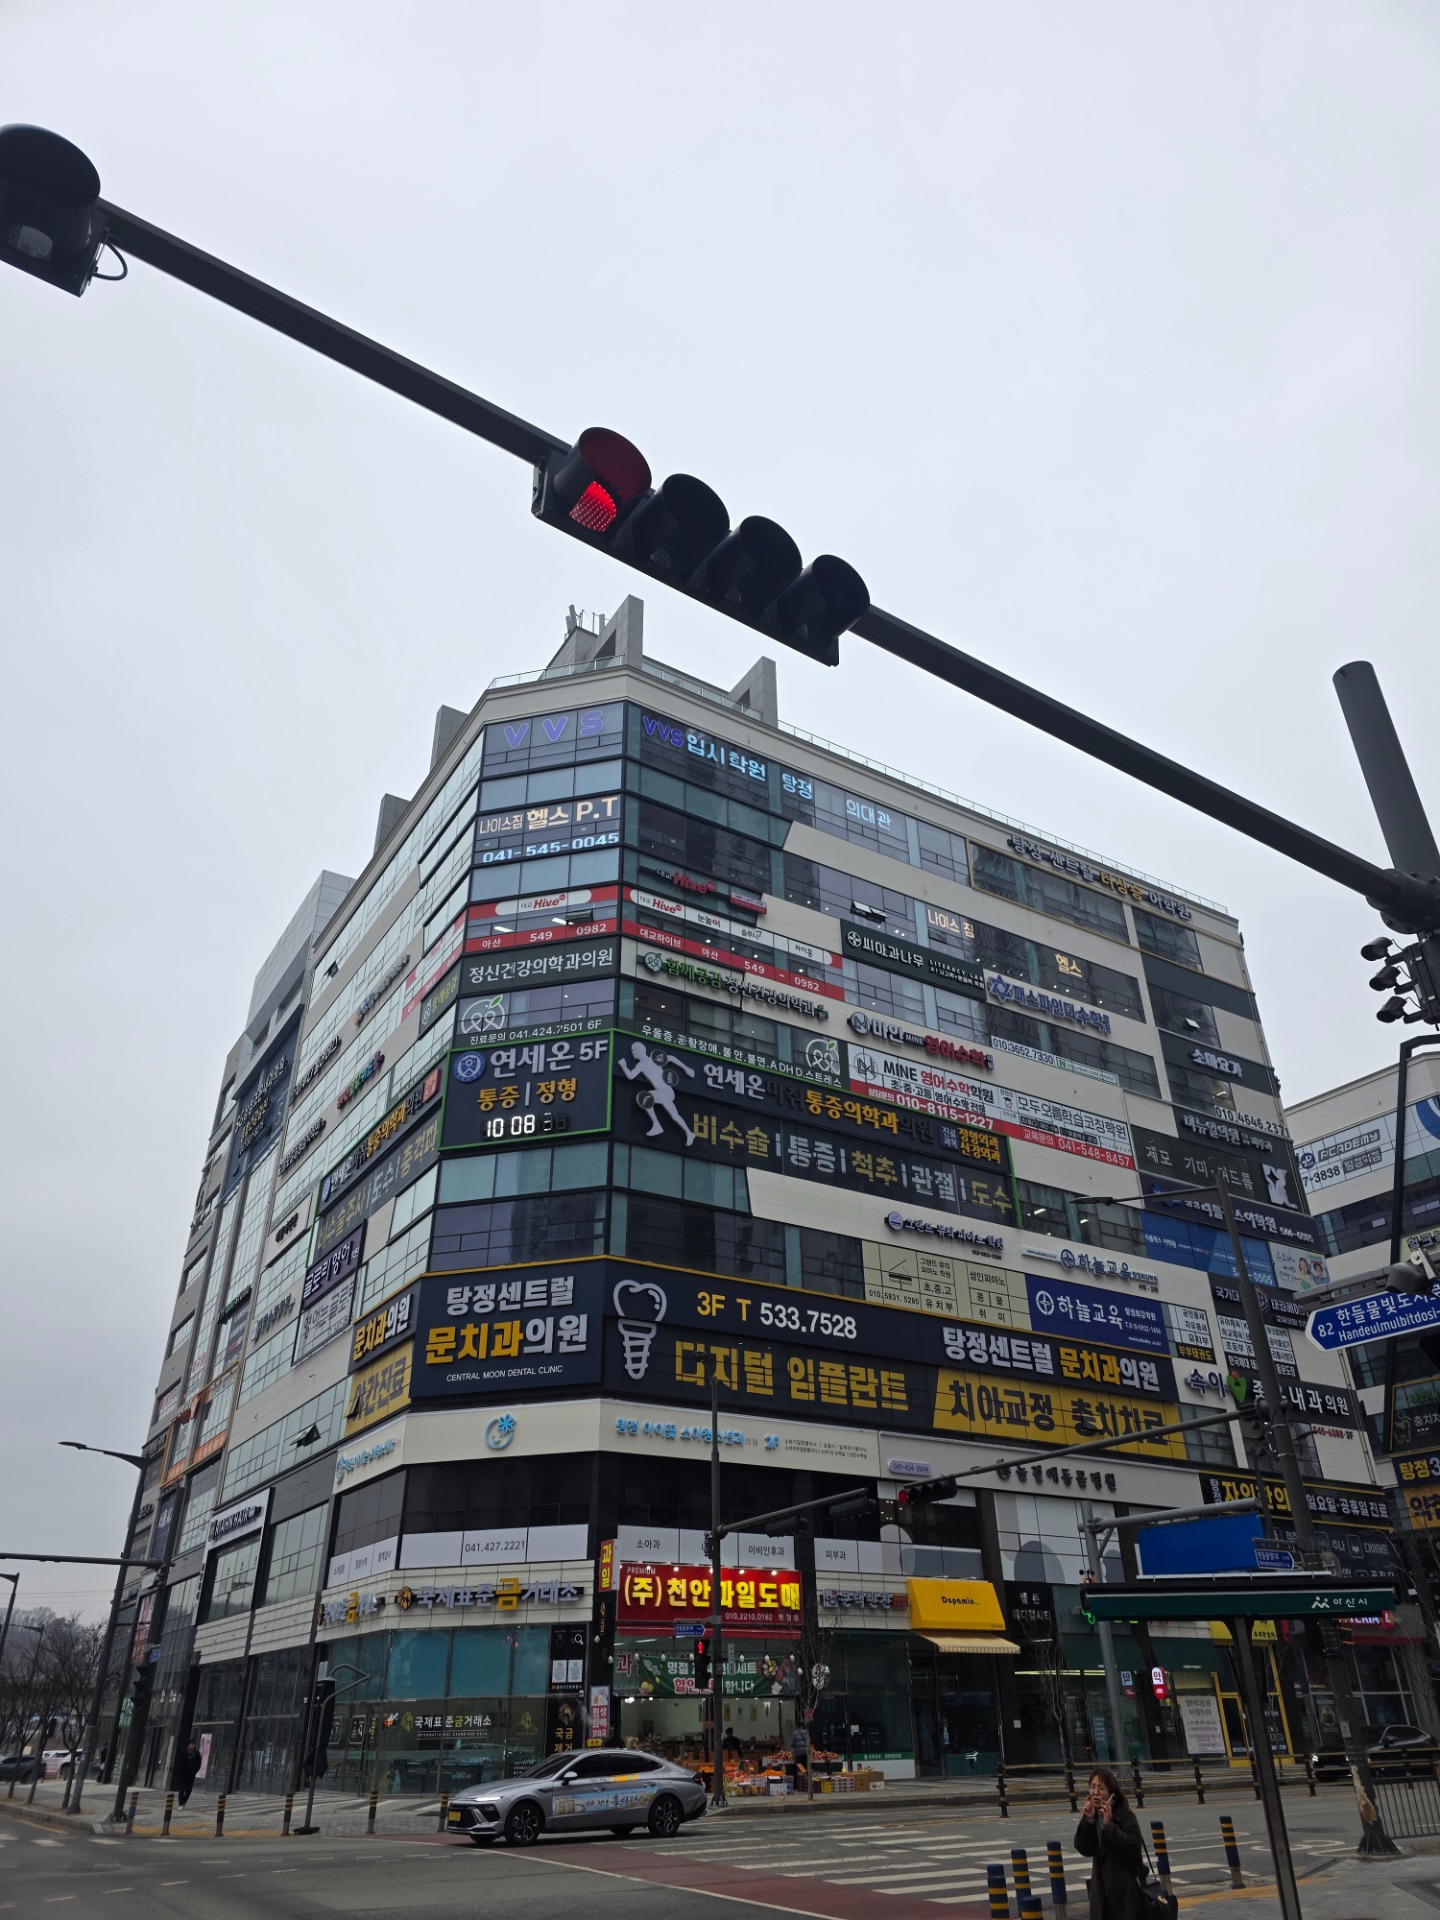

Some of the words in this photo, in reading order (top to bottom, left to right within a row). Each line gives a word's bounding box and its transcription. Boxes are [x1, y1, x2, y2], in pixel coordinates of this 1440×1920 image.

[504, 710, 604, 748] VVS
[782, 772, 813, 800] 탕정
[527, 805, 569, 830] 헬스
[482, 832, 619, 863] 041-545-0045
[534, 895, 560, 908] Hive
[652, 898, 676, 914] Hive
[697, 913, 721, 928] 눈높이
[482, 938, 501, 949] 아산
[530, 930, 552, 943] 549
[576, 923, 607, 936] 0982
[469, 948, 613, 984] 정신건강의학과의원
[640, 928, 682, 948] 대교하이브
[702, 947, 718, 961] 아산
[744, 961, 765, 974] 549
[794, 977, 819, 992] 0982
[1055, 952, 1082, 977] 헬스
[509, 1022, 583, 1041] 041.424.7501
[587, 1019, 602, 1030] 6F
[872, 1017, 904, 1043] 마인
[490, 1041, 575, 1079] 연세온
[579, 1040, 608, 1061] 5F
[883, 1060, 917, 1082] MINE
[477, 1085, 520, 1111] 통증
[536, 1078, 577, 1104] 정형
[703, 1063, 766, 1100] 연세온
[693, 1113, 770, 1158] 비수술
[787, 1135, 836, 1174] 통증
[851, 1150, 898, 1186] 척추
[911, 1165, 956, 1202] 관절
[971, 1180, 1013, 1214] 도수
[1059, 1138, 1130, 1166] 041-548-8457
[447, 1276, 575, 1316] 탕정센트럴
[353, 1293, 412, 1361] 문치과의원
[697, 1292, 726, 1316] 3F
[736, 1298, 752, 1321] T
[760, 1302, 857, 1339] 533.7528
[1057, 1296, 1122, 1330] 하늘교육
[425, 1314, 589, 1365] 문치과의원
[1318, 1322, 1334, 1337] 82
[446, 1370, 480, 1382] CENTRAL
[483, 1369, 505, 1378] MOON
[507, 1366, 537, 1377] DENTAL
[538, 1364, 563, 1374] CLINIC
[942, 1326, 1054, 1375] 탕정센트럴
[1059, 1347, 1160, 1392] 문치과의원
[675, 1340, 773, 1396] 디지털
[787, 1356, 909, 1411] 임플란트
[951, 1378, 1056, 1432] 치아교정
[1189, 1369, 1226, 1397] 속이
[1326, 1395, 1350, 1415] 의원
[1399, 1460, 1430, 1481] 탕정
[465, 1541, 525, 1553] 041.427.2221
[636, 1539, 660, 1549] 소아과
[602, 1544, 611, 1588] 과일
[628, 1567, 656, 1575] PREMIUM
[417, 1577, 579, 1611] 국제표준금거래소
[667, 1661, 689, 1675] 명절
[414, 1714, 492, 1727] 국제표준금거래소
